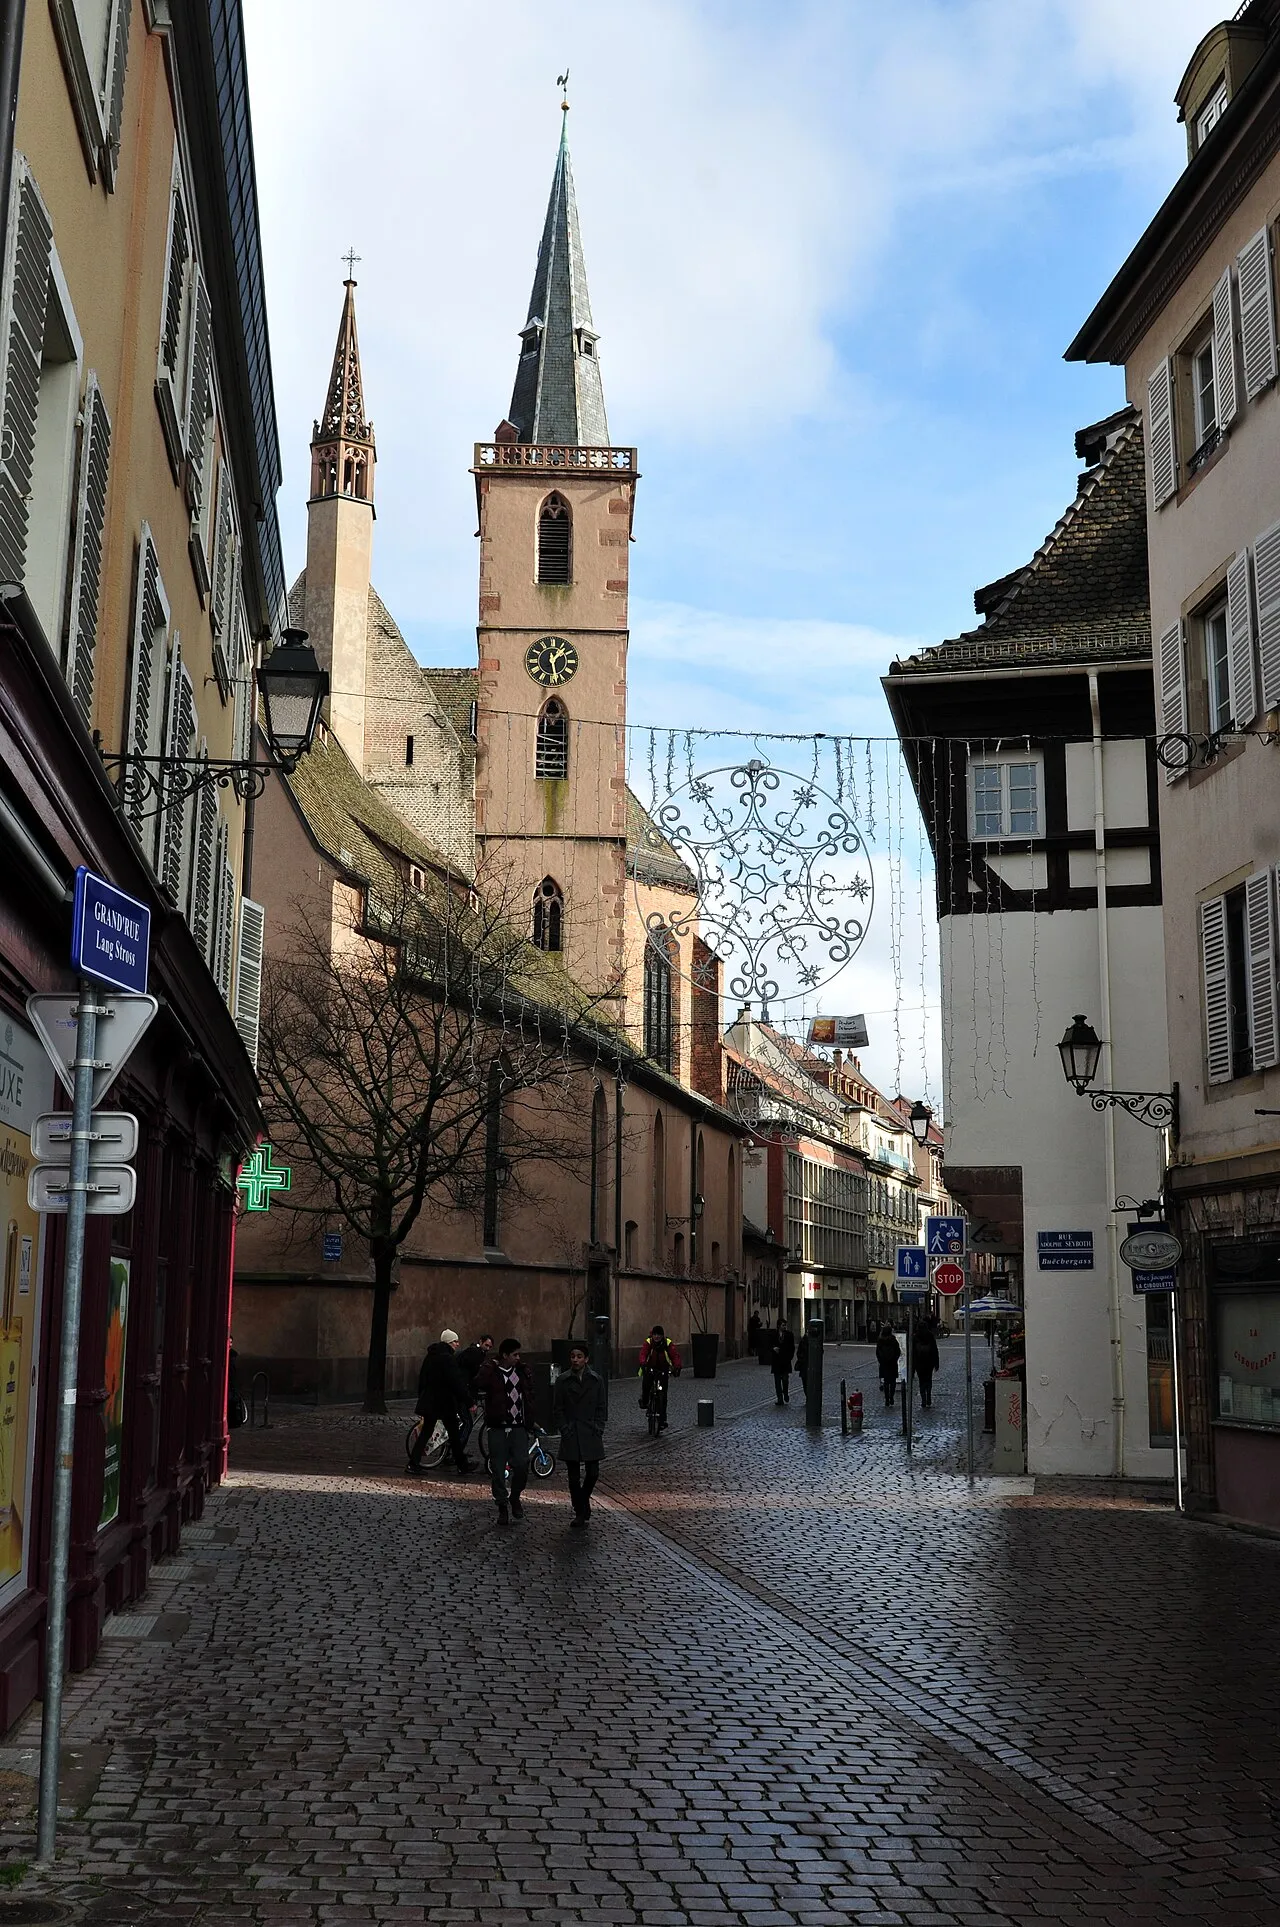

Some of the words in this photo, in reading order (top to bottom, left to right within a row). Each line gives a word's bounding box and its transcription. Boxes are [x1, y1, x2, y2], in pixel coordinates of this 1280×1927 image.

[94, 901, 140, 942] GRAND'RUE
[95, 930, 114, 961] Lang
[114, 940, 136, 967] Stross
[1058, 1233, 1073, 1241] RUE
[937, 1274, 962, 1284] STOP
